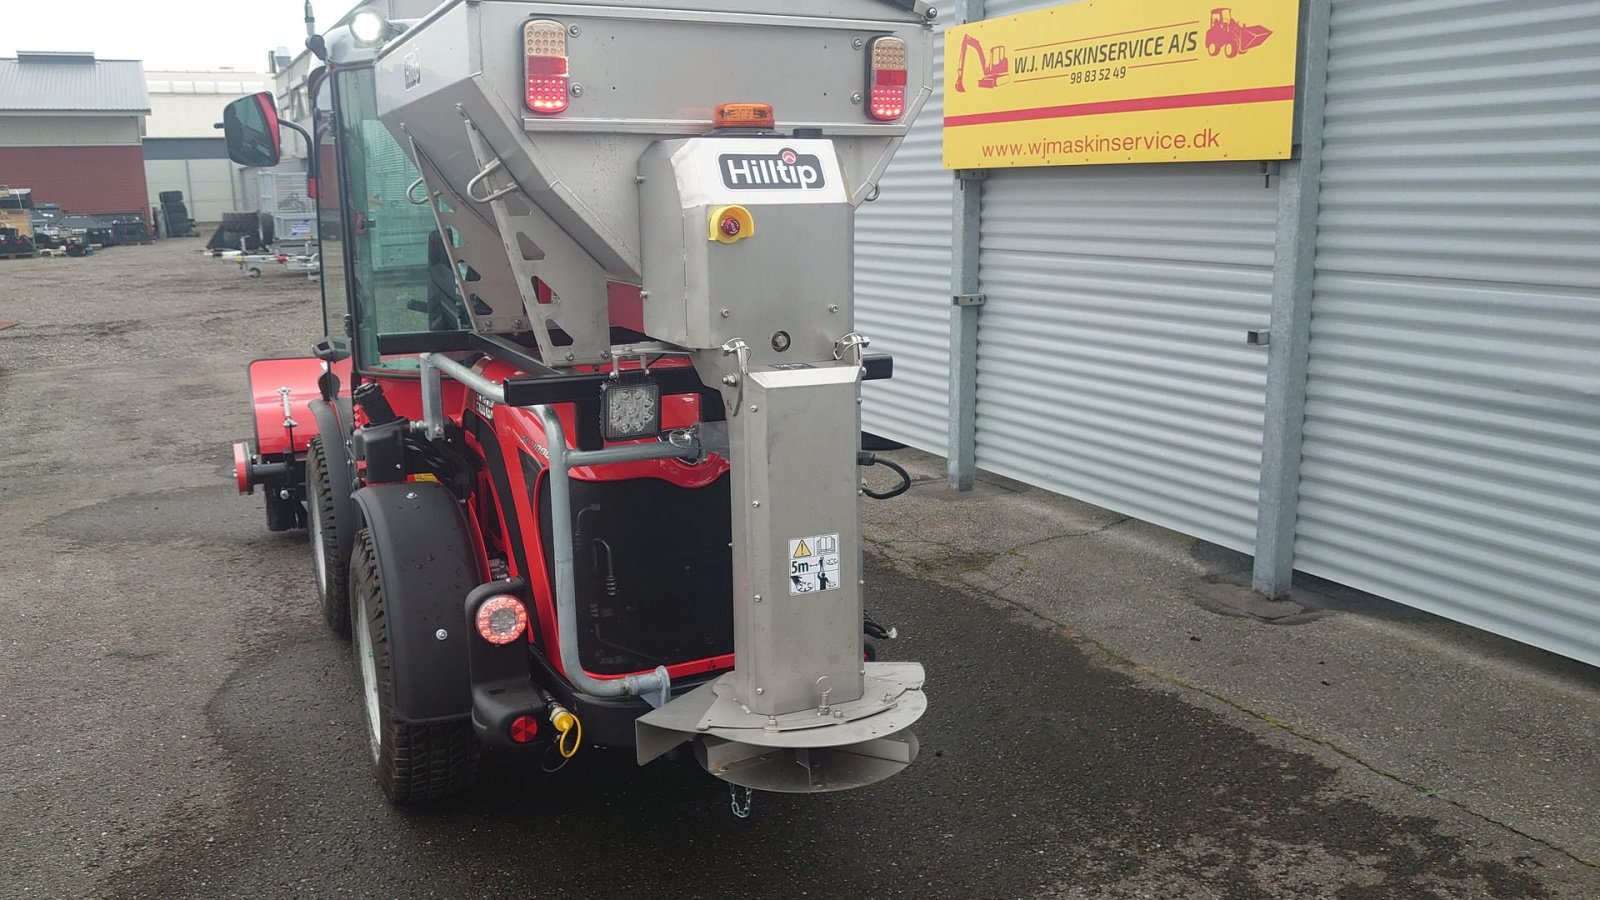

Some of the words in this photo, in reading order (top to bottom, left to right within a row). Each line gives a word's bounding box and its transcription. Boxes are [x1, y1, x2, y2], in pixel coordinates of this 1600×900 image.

[1014, 55, 1038, 74] W.J.
[1041, 36, 1164, 71] MASKINSERVICE
[1168, 31, 1198, 54] A/S
[1070, 72, 1083, 84] 98
[1084, 69, 1097, 83] 83
[1098, 67, 1111, 81] 52
[1113, 66, 1126, 79] 49
[982, 128, 1220, 159] www.wjmaskinservice.dk
[727, 158, 818, 189] Hilltip
[791, 560, 809, 574] 5m
